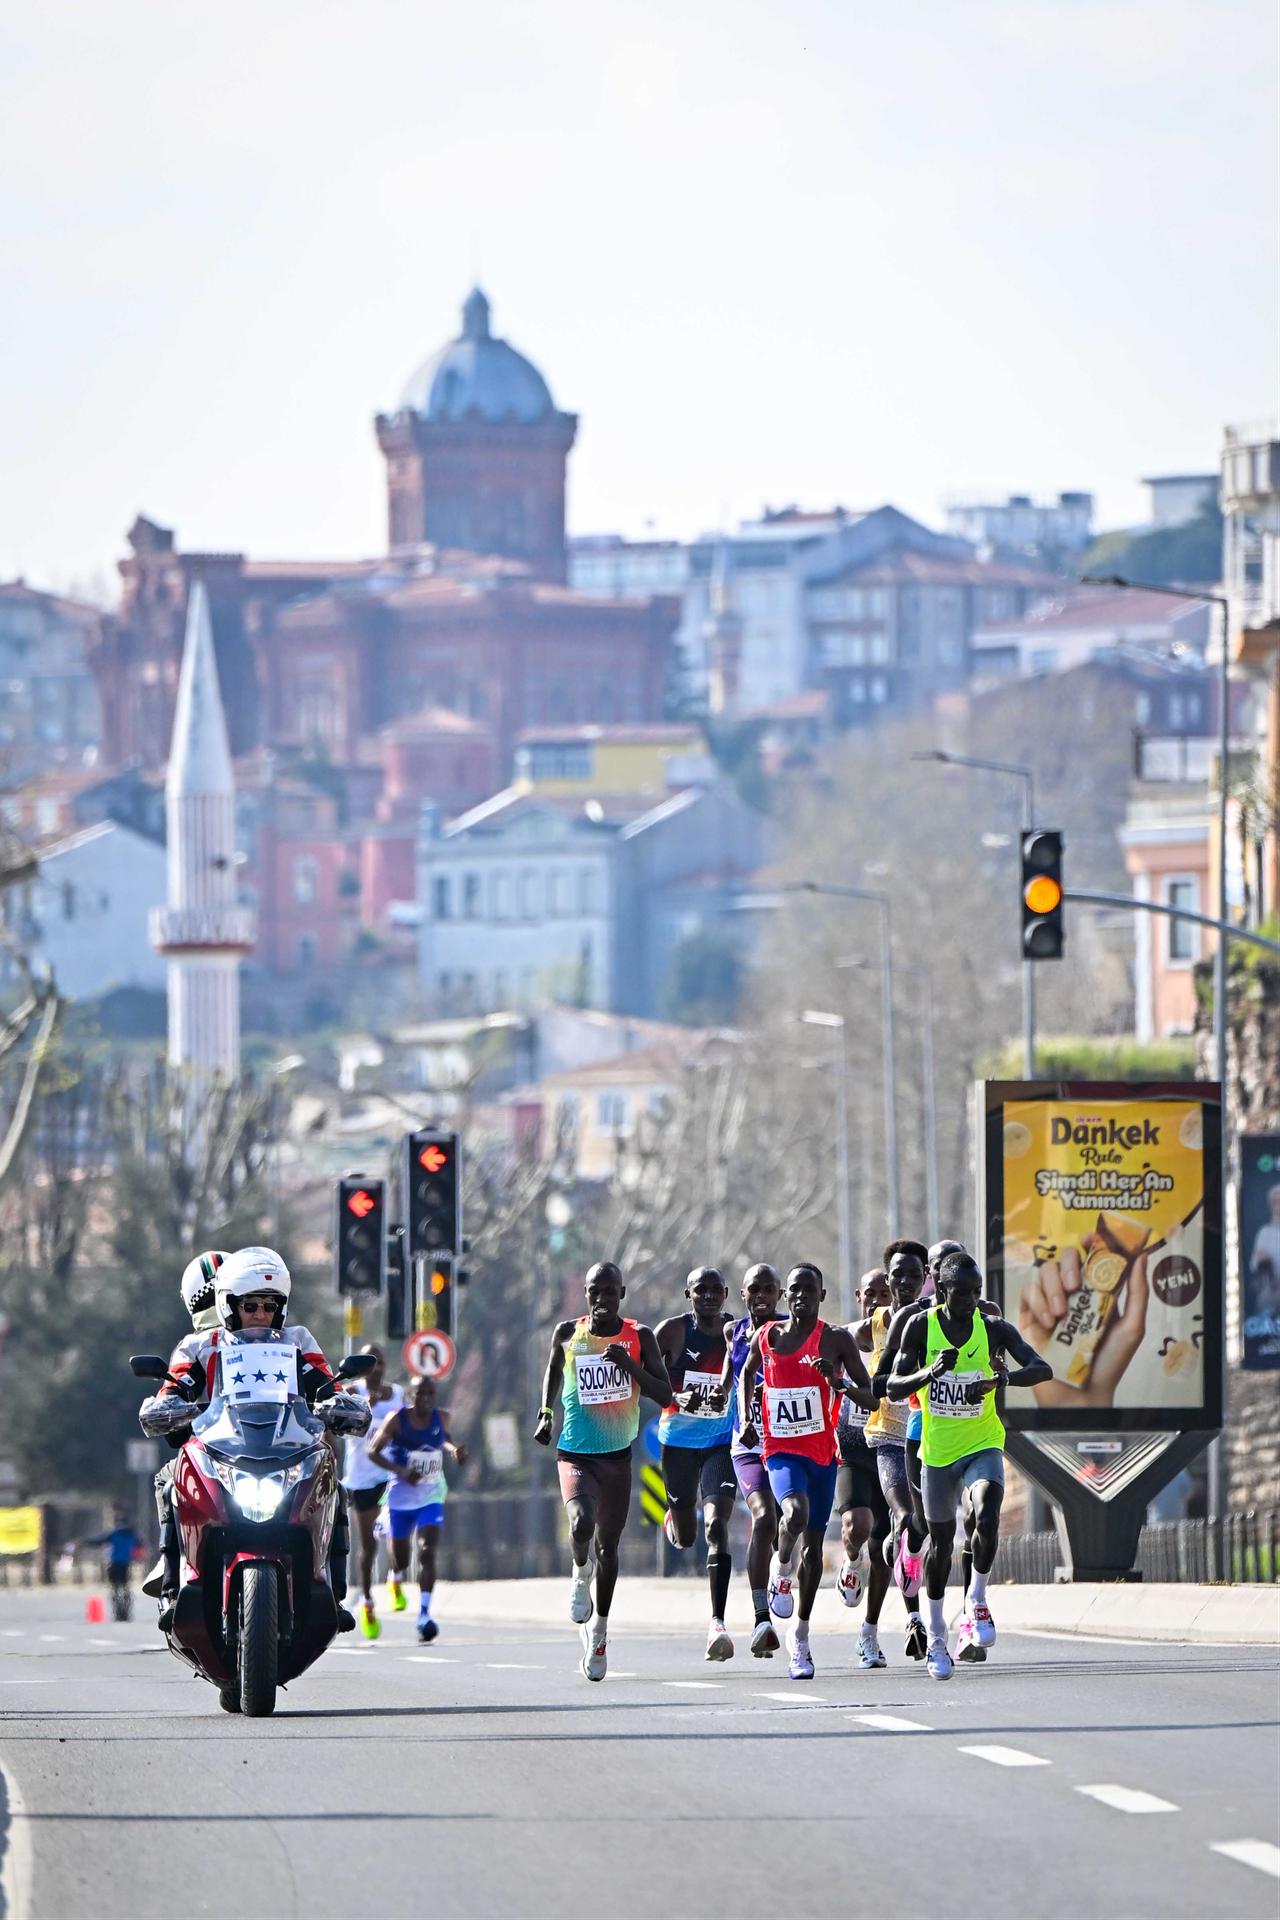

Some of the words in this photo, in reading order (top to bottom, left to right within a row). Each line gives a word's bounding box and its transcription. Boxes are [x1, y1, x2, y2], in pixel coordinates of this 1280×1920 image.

[1051, 1117, 1160, 1150] Dankek
[1035, 1169, 1097, 1195] Şimdi
[1100, 1169, 1142, 1191] Her
[1143, 1169, 1174, 1191] An
[1059, 1190, 1152, 1210] Yanında!
[1056, 1284, 1095, 1347] Dankek
[579, 1366, 630, 1391] SOLOMON
[930, 1380, 967, 1406] BENA
